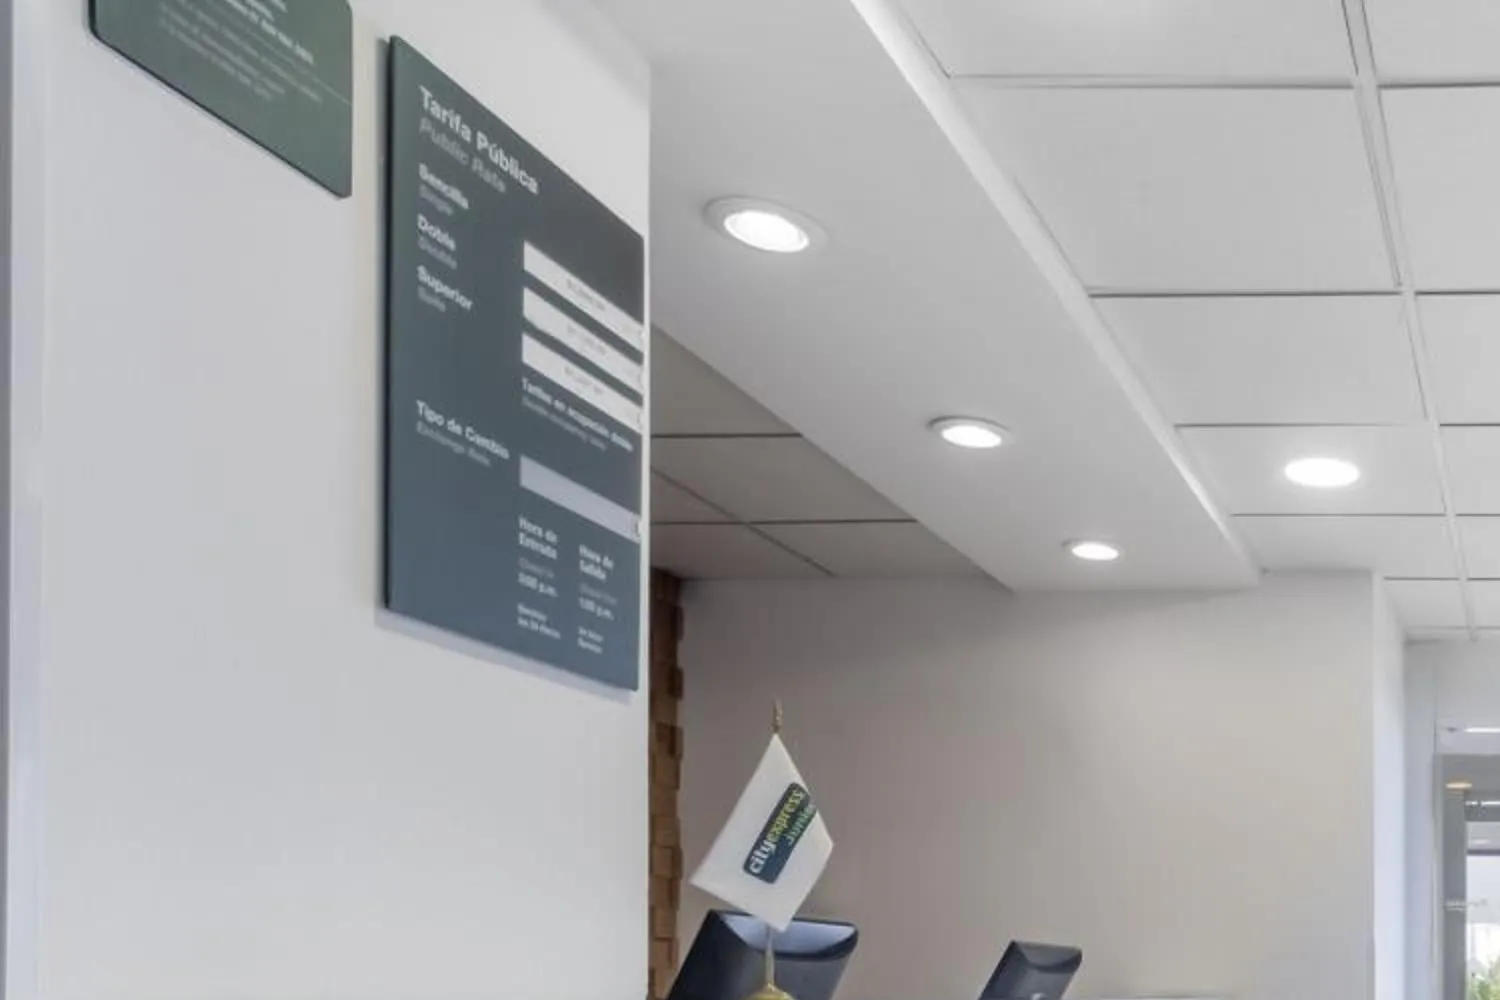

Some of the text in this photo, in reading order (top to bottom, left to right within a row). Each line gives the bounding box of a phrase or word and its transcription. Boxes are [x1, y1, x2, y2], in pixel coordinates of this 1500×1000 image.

[419, 84, 538, 195] Tarifa Pública
[419, 117, 470, 166] Public
[417, 213, 456, 251] Doble
[417, 265, 473, 311] Superior
[416, 400, 445, 427] Tipo
[447, 418, 462, 436] de
